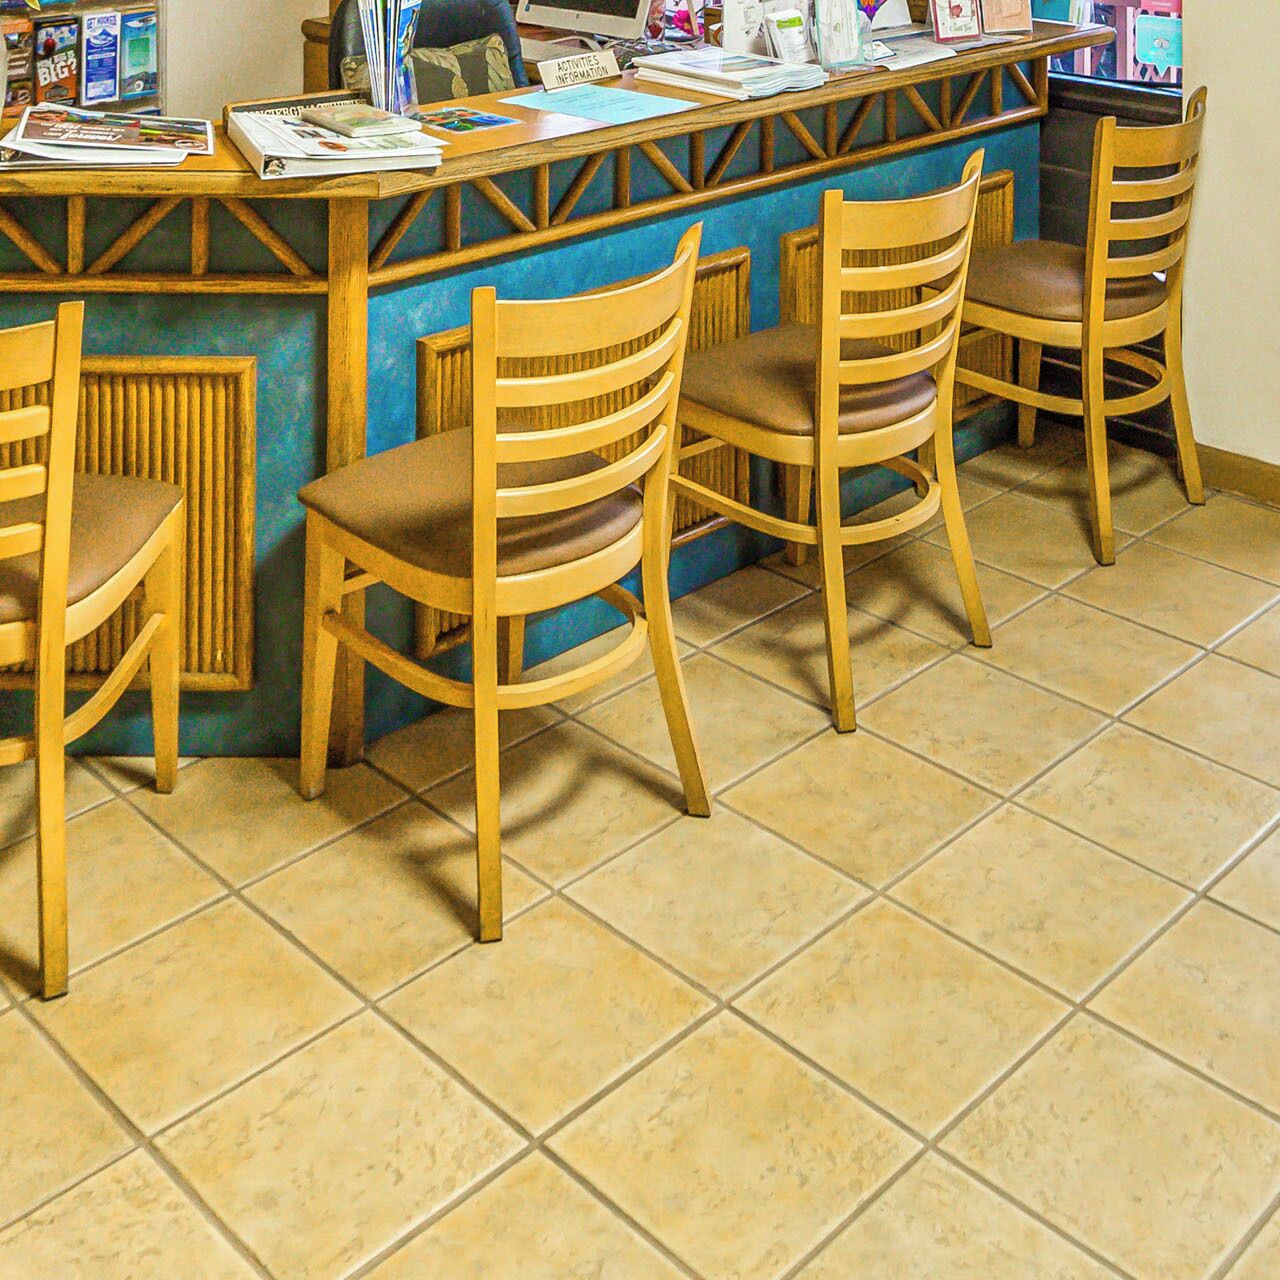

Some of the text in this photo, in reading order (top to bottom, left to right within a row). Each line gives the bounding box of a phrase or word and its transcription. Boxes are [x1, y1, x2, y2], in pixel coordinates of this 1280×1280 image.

[37, 59, 77, 87] BIG?
[556, 54, 600, 72] ACTIVITIES
[555, 65, 609, 86] INFORMATION
